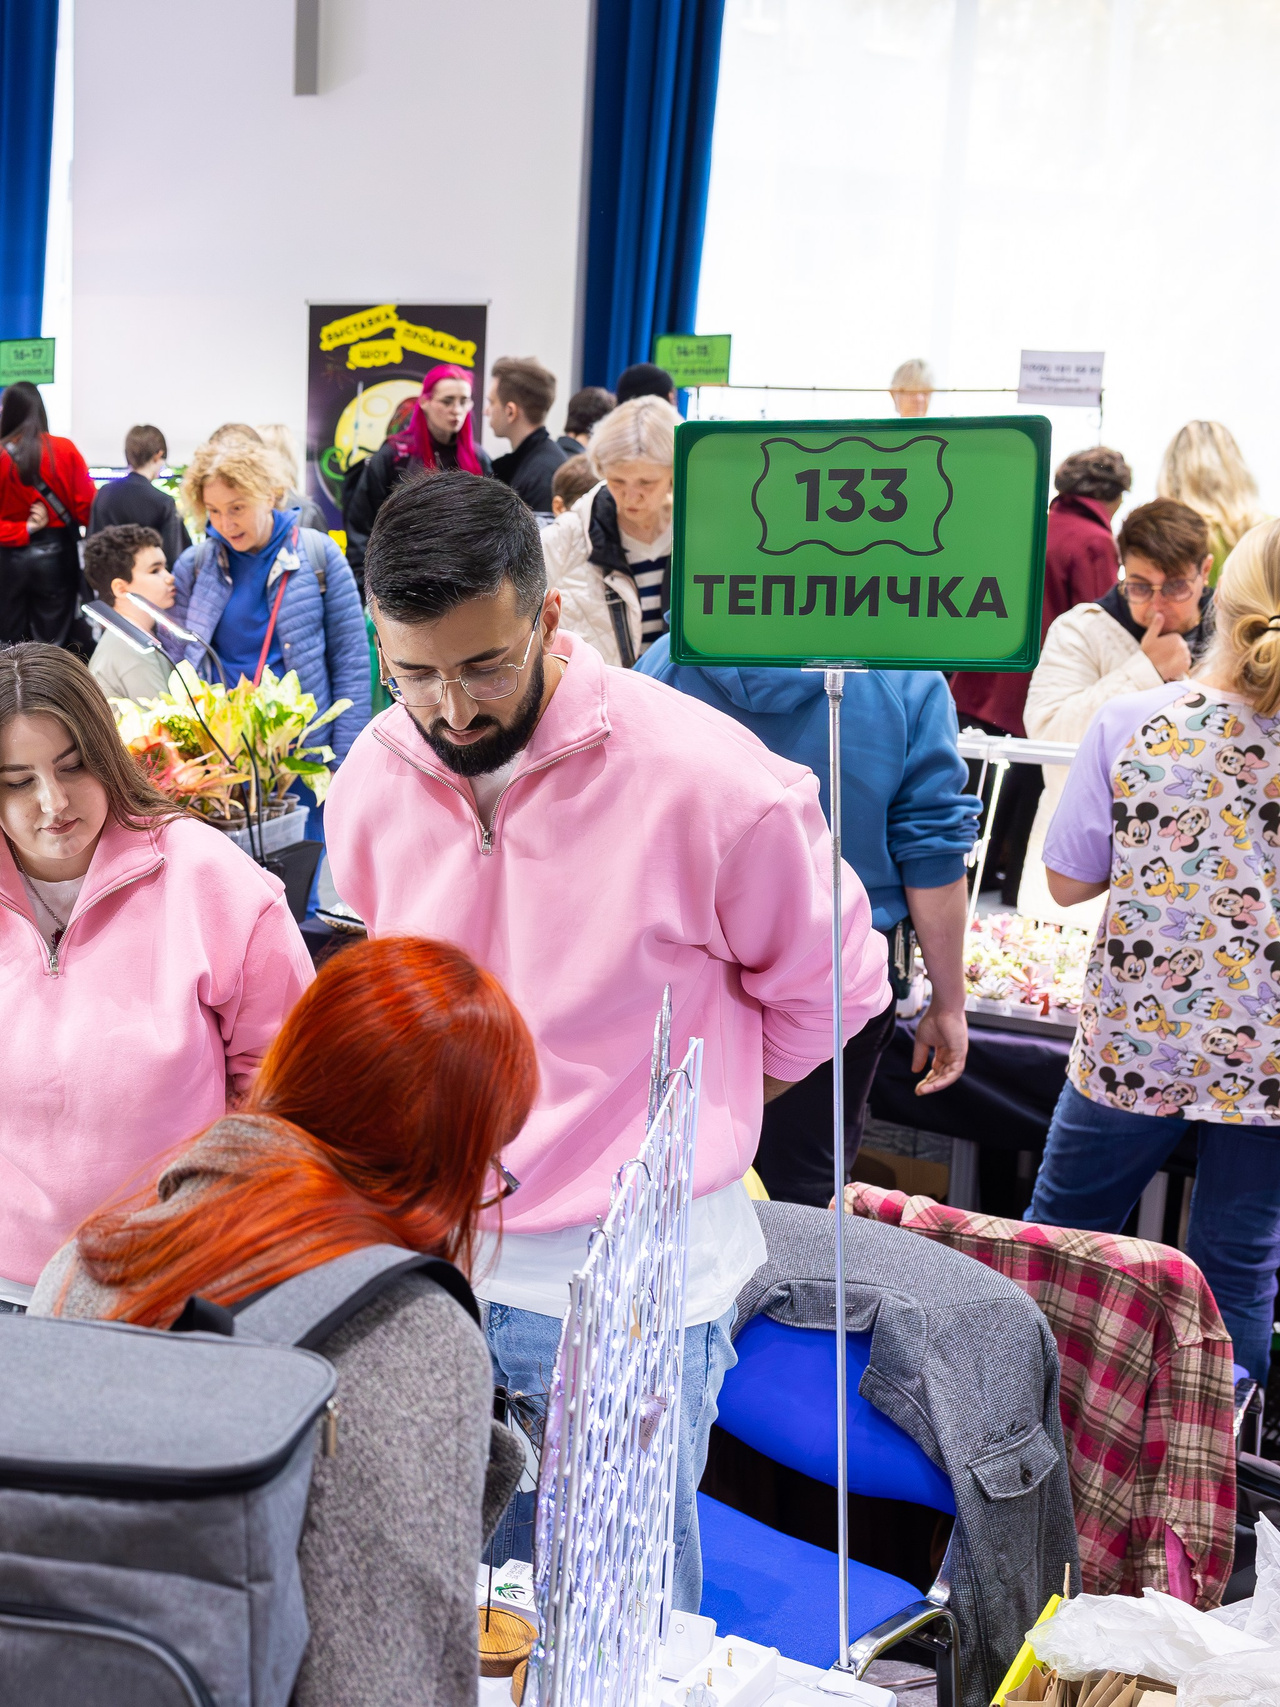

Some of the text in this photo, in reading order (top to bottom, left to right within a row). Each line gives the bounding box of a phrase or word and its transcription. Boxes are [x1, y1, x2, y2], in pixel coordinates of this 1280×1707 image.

[359, 350, 389, 359] ШОУ
[794, 468, 909, 523] 133
[693, 574, 1009, 619] ТЕПЛИЧКА
